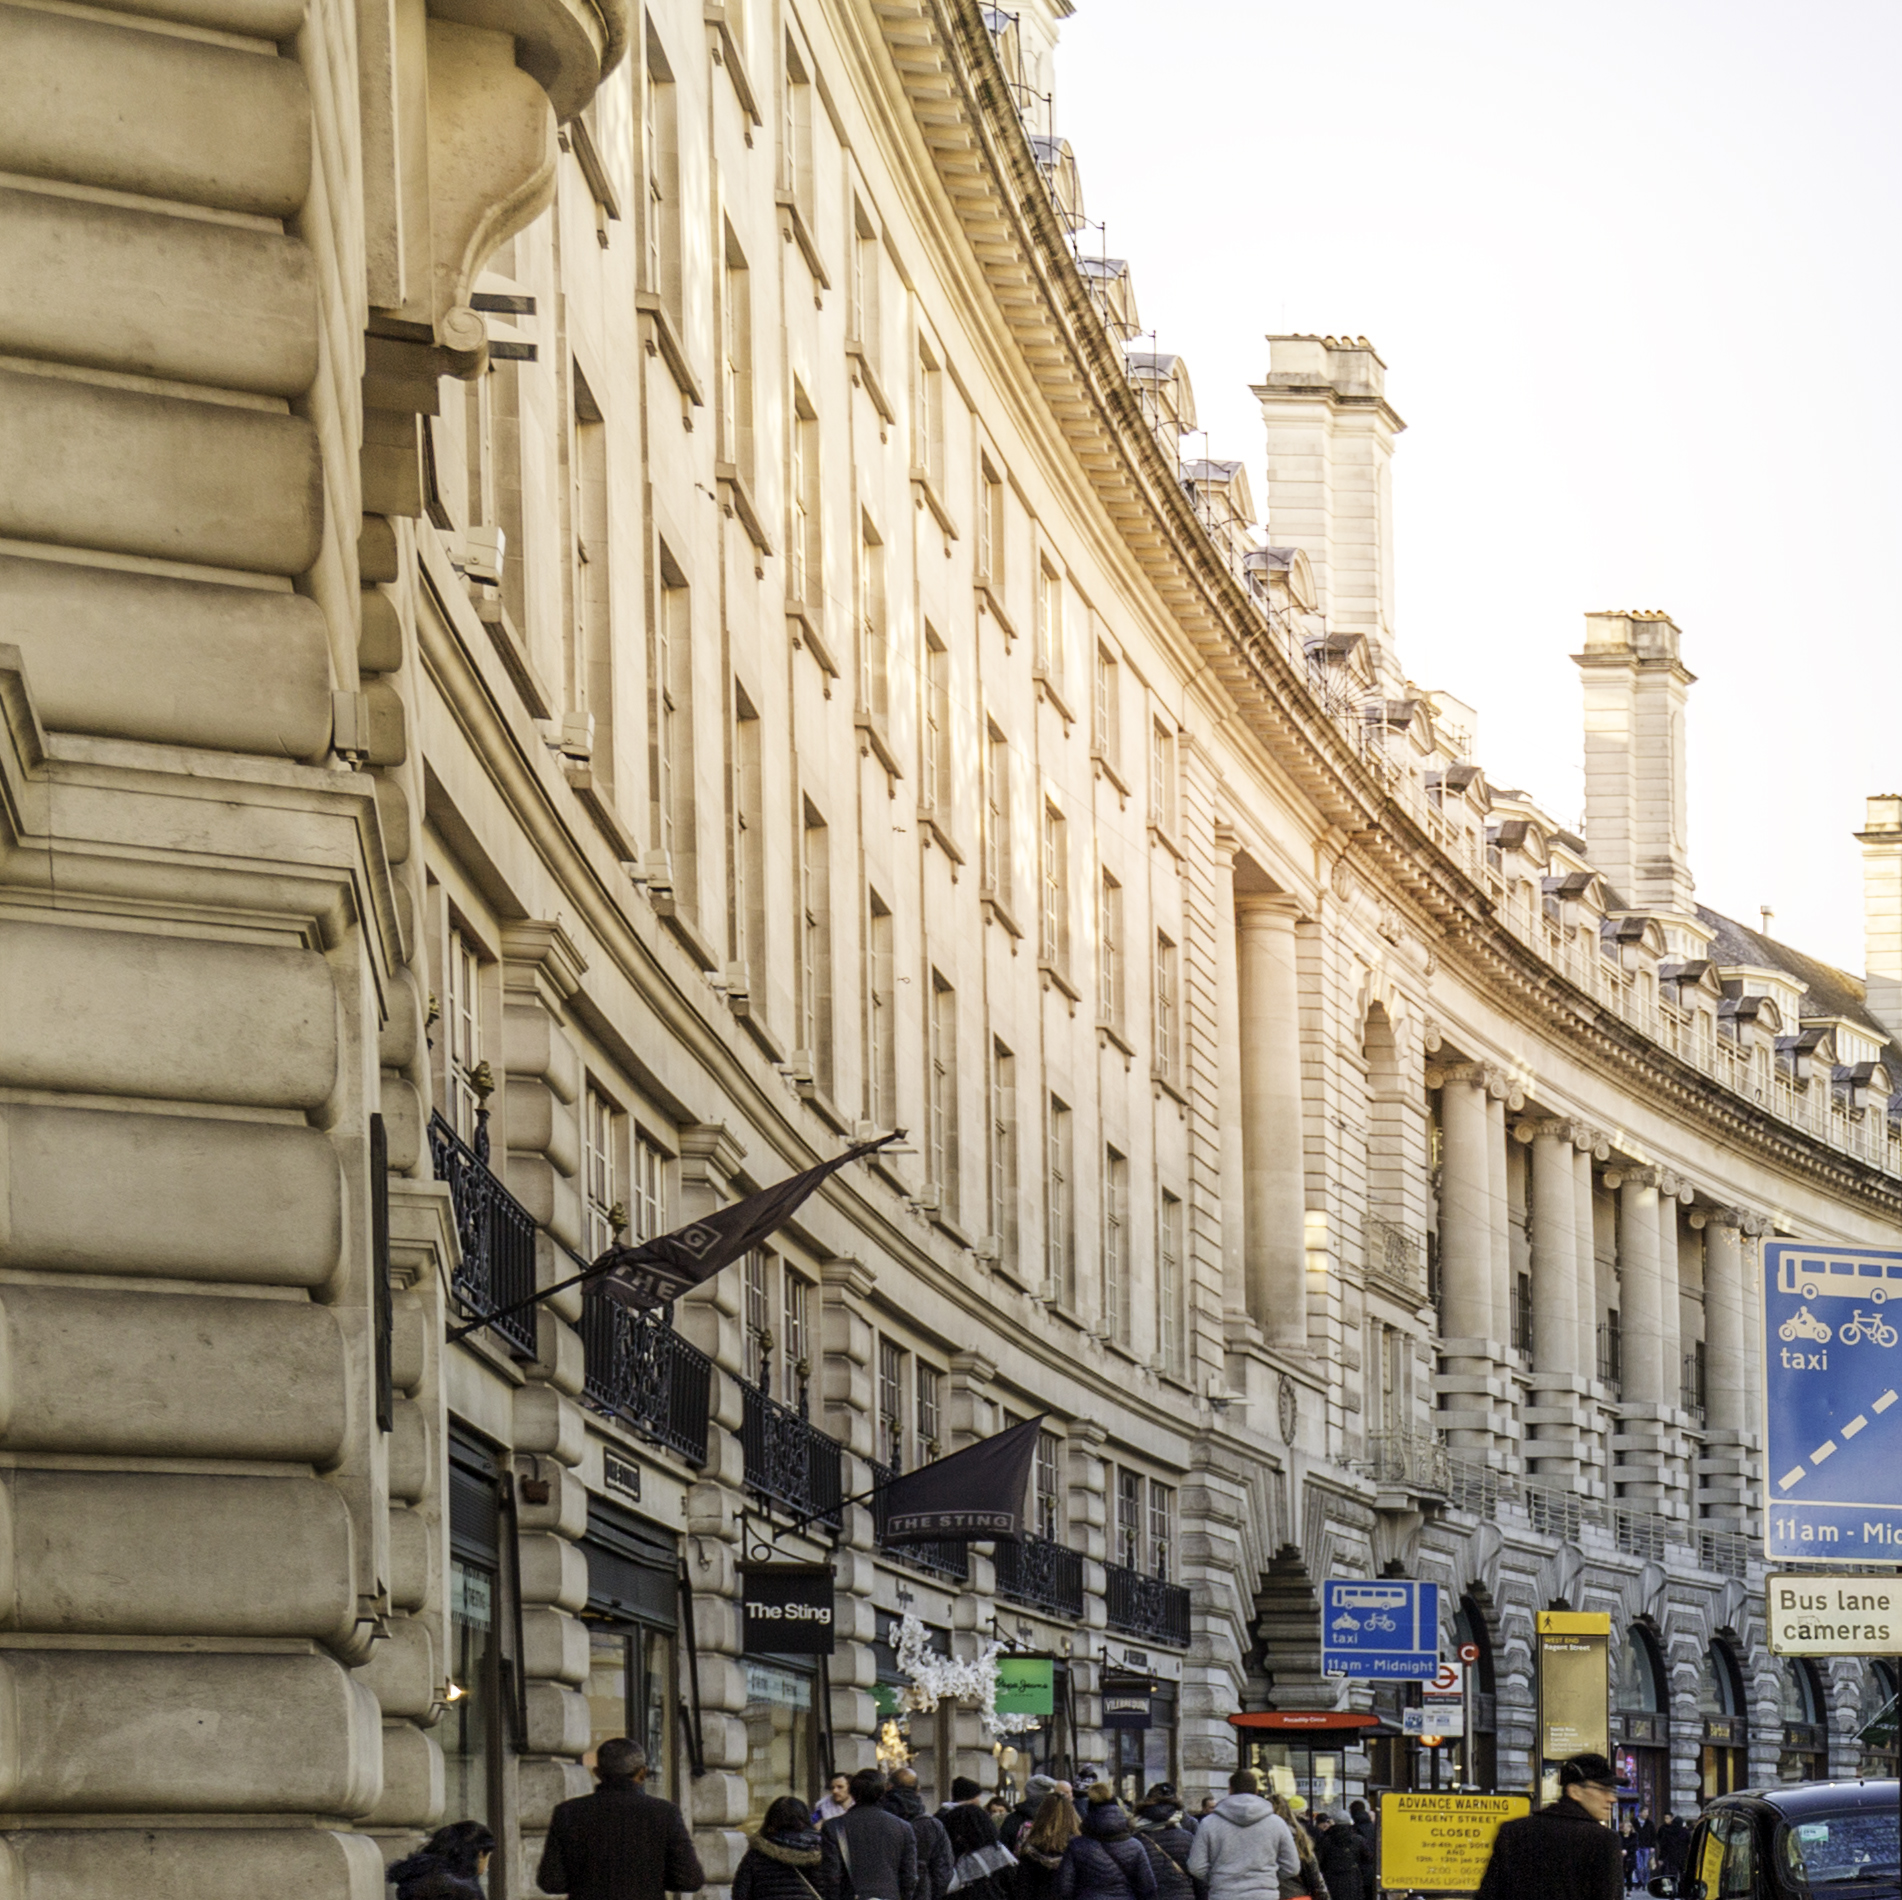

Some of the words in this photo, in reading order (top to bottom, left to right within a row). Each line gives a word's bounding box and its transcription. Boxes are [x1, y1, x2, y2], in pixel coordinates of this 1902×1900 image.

[1780, 1347, 1828, 1371] taxi
[893, 1515, 935, 1530] THE
[938, 1513, 1009, 1529] STING
[1774, 1518, 1839, 1542] 11am
[1780, 1589, 1828, 1611] Bus
[1837, 1589, 1890, 1611] lane
[745, 1602, 782, 1620] The
[783, 1603, 832, 1625] Sting
[1332, 1632, 1358, 1644] taxi
[1783, 1622, 1891, 1641] cameras
[1461, 1645, 1476, 1661] C
[1544, 1643, 1568, 1651] Regent
[1327, 1658, 1362, 1671] 11am
[1373, 1659, 1435, 1674] Midnight
[1398, 1797, 1451, 1811] ADVANCE
[1455, 1798, 1509, 1811] WARNING
[1410, 1814, 1453, 1823] REGENT
[1457, 1815, 1498, 1824] STREET
[1430, 1828, 1481, 1837] CLOSED
[1384, 1876, 1442, 1886] CHRISTMAS
